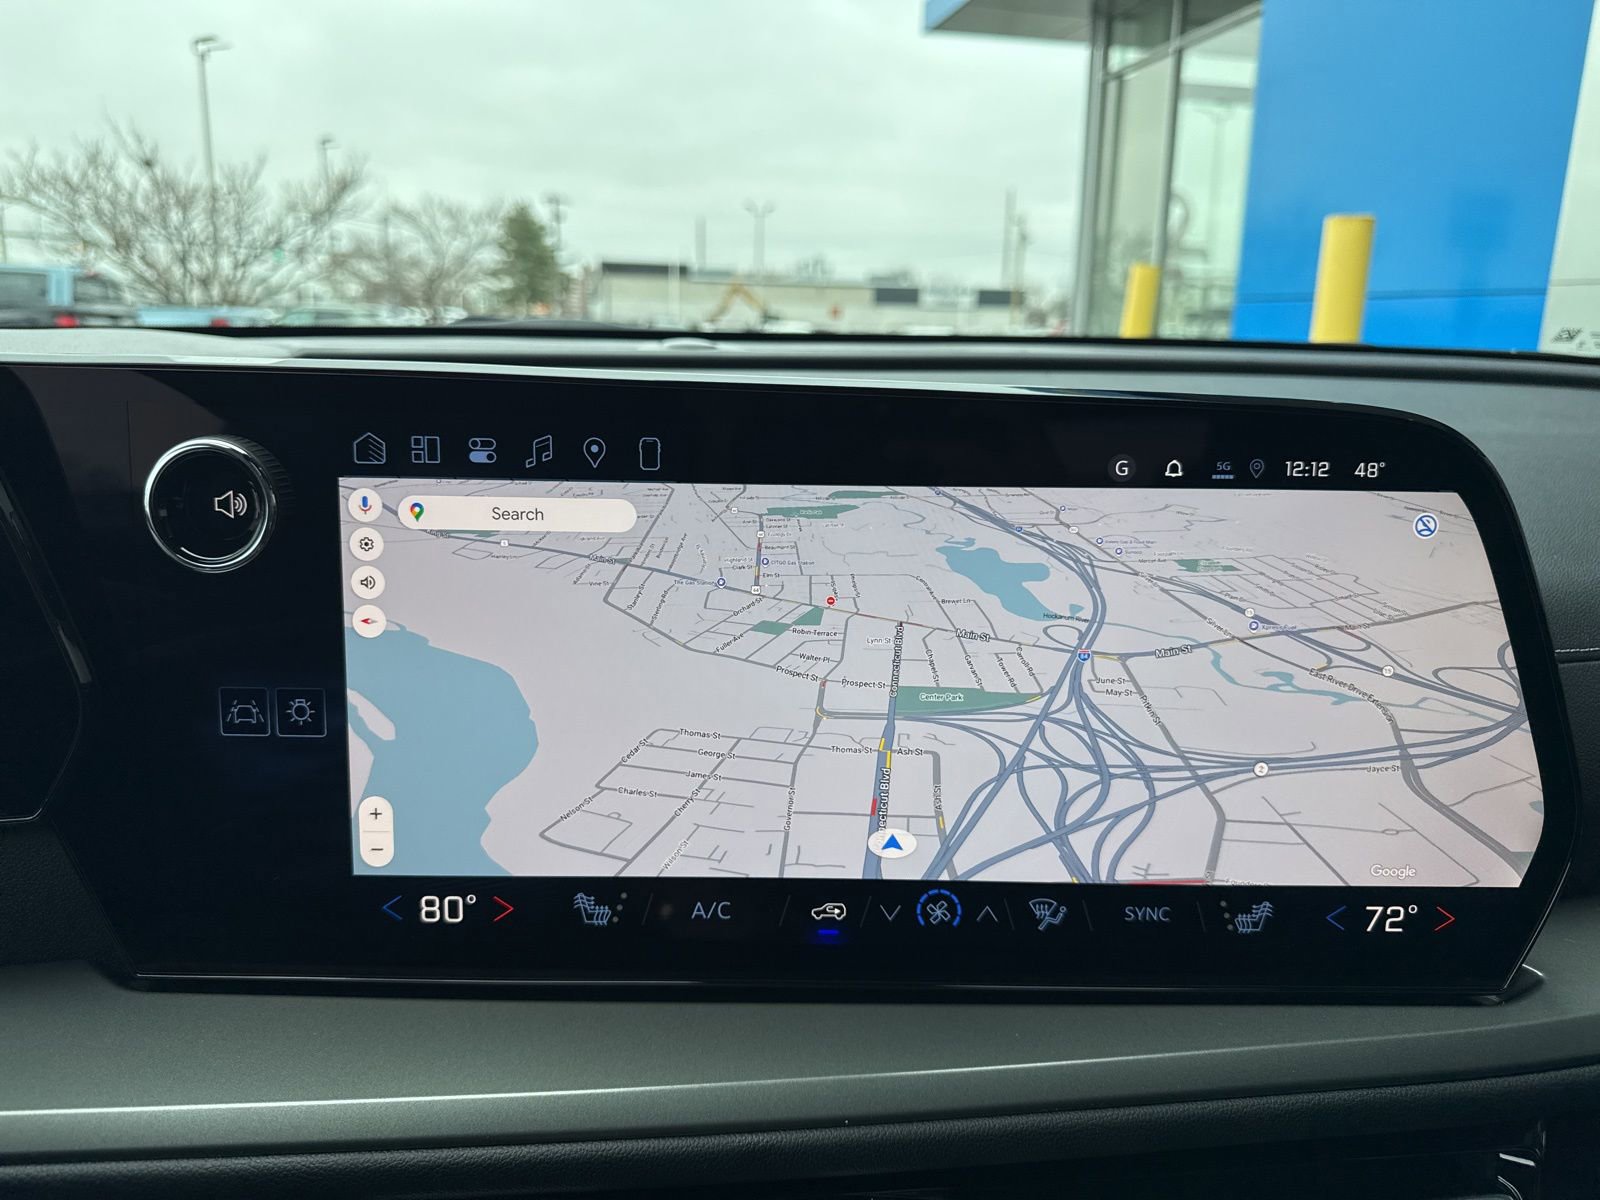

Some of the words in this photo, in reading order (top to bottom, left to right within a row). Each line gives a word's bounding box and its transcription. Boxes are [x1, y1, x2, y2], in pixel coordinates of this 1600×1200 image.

[1216, 462, 1231, 471] 5G
[1285, 461, 1330, 477] 12:12
[1354, 461, 1385, 478] 48°
[491, 506, 544, 521] Search
[627, 590, 643, 611] Stanley
[651, 596, 666, 621] Sterling
[661, 590, 668, 598] Rd
[732, 602, 756, 617] Orchard
[791, 627, 812, 635] Robin
[813, 629, 838, 638] Terrace
[1206, 616, 1225, 633] Silver
[866, 637, 882, 645] Lynn
[955, 627, 978, 641] Main
[979, 633, 991, 642] St
[715, 640, 733, 654] Fuller
[733, 632, 745, 642] Ave
[799, 652, 821, 662] Walter
[822, 656, 831, 664] Pl
[1154, 646, 1180, 659] Main
[1181, 644, 1193, 655] St
[925, 648, 938, 675] Chapel
[933, 673, 940, 685] St
[1015, 645, 1031, 671] Carroll
[1026, 666, 1035, 678] Rd
[775, 665, 810, 681] Prospect
[810, 674, 819, 682] St
[889, 645, 903, 698] Connecticut
[964, 654, 978, 678] Garvan
[974, 676, 983, 687] St
[996, 657, 1012, 679] Tower
[1008, 677, 1017, 688] Rd
[841, 678, 876, 689] Prospect
[877, 681, 886, 689] St
[1095, 676, 1116, 685] June
[1117, 677, 1126, 685] St
[920, 693, 944, 701] Center
[945, 693, 964, 701] Park
[1105, 688, 1122, 697] May
[1123, 688, 1133, 697] St
[1308, 667, 1327, 681] East
[1326, 674, 1348, 688] River
[1347, 683, 1368, 698] Drive
[1366, 693, 1394, 724] Extension
[1139, 694, 1156, 720] Pitkin
[1152, 715, 1162, 727] St
[679, 728, 711, 739] Thomas
[712, 731, 721, 740] St
[620, 744, 641, 764] Cedar
[639, 737, 649, 747] St
[697, 748, 726, 760] George
[727, 752, 736, 760] St
[831, 745, 862, 754] Thomas
[863, 746, 873, 754] St
[896, 748, 913, 756] Ash
[914, 748, 923, 756] St
[685, 770, 711, 780] James
[712, 773, 722, 781] St
[1258, 765, 1265, 773] 2
[1366, 765, 1389, 774] Jayce
[1390, 764, 1400, 772] St
[879, 767, 891, 790] Blvd
[617, 786, 647, 797] Charles
[648, 790, 658, 798] St
[788, 786, 796, 797] St
[934, 785, 942, 794] St
[560, 803, 585, 822] Nelson
[583, 796, 593, 806] St
[673, 796, 695, 817] Cherry
[691, 787, 701, 798] St
[934, 794, 943, 811] Ash
[784, 797, 796, 831] Governor
[662, 846, 683, 870] Wilson
[680, 840, 689, 849] St
[1370, 864, 1417, 878] Google
[419, 893, 477, 924] 80°
[691, 901, 732, 920] A/C
[1124, 905, 1171, 923] SYNC
[1365, 904, 1419, 933] 72°
